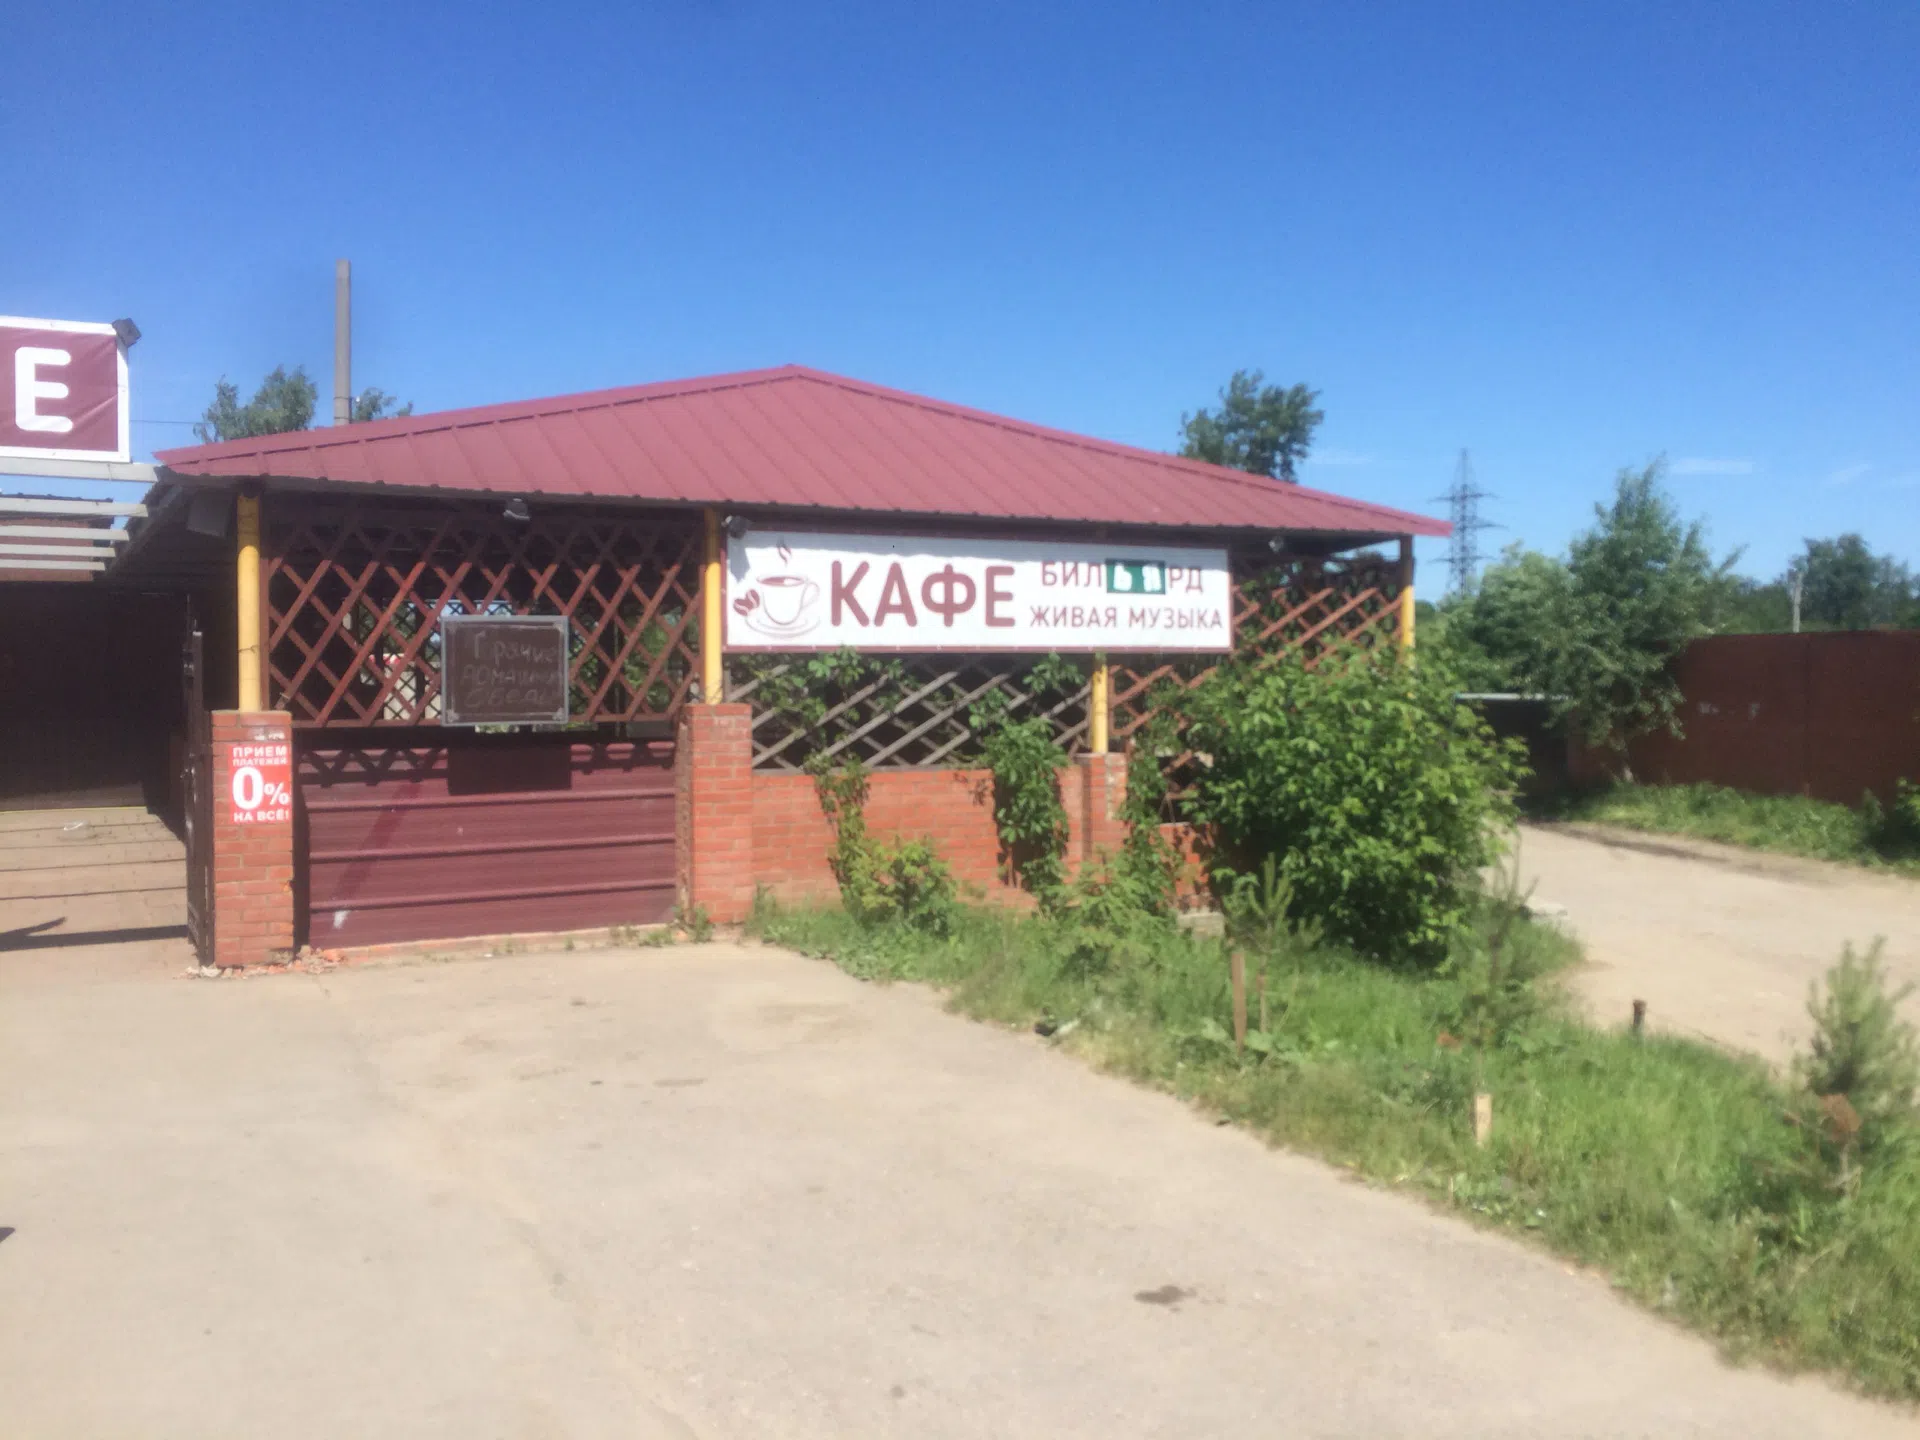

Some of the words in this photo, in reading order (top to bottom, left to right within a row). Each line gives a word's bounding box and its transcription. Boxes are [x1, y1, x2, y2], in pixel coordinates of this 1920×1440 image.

[15, 346, 73, 433] Е
[831, 560, 1015, 627] КАФЕ
[1030, 605, 1118, 628] ЖИВАЯ
[1128, 606, 1222, 629] МУЗЫКА
[233, 745, 287, 758] ПРИЕМ
[232, 766, 290, 811] 0%
[233, 811, 254, 822] НА
